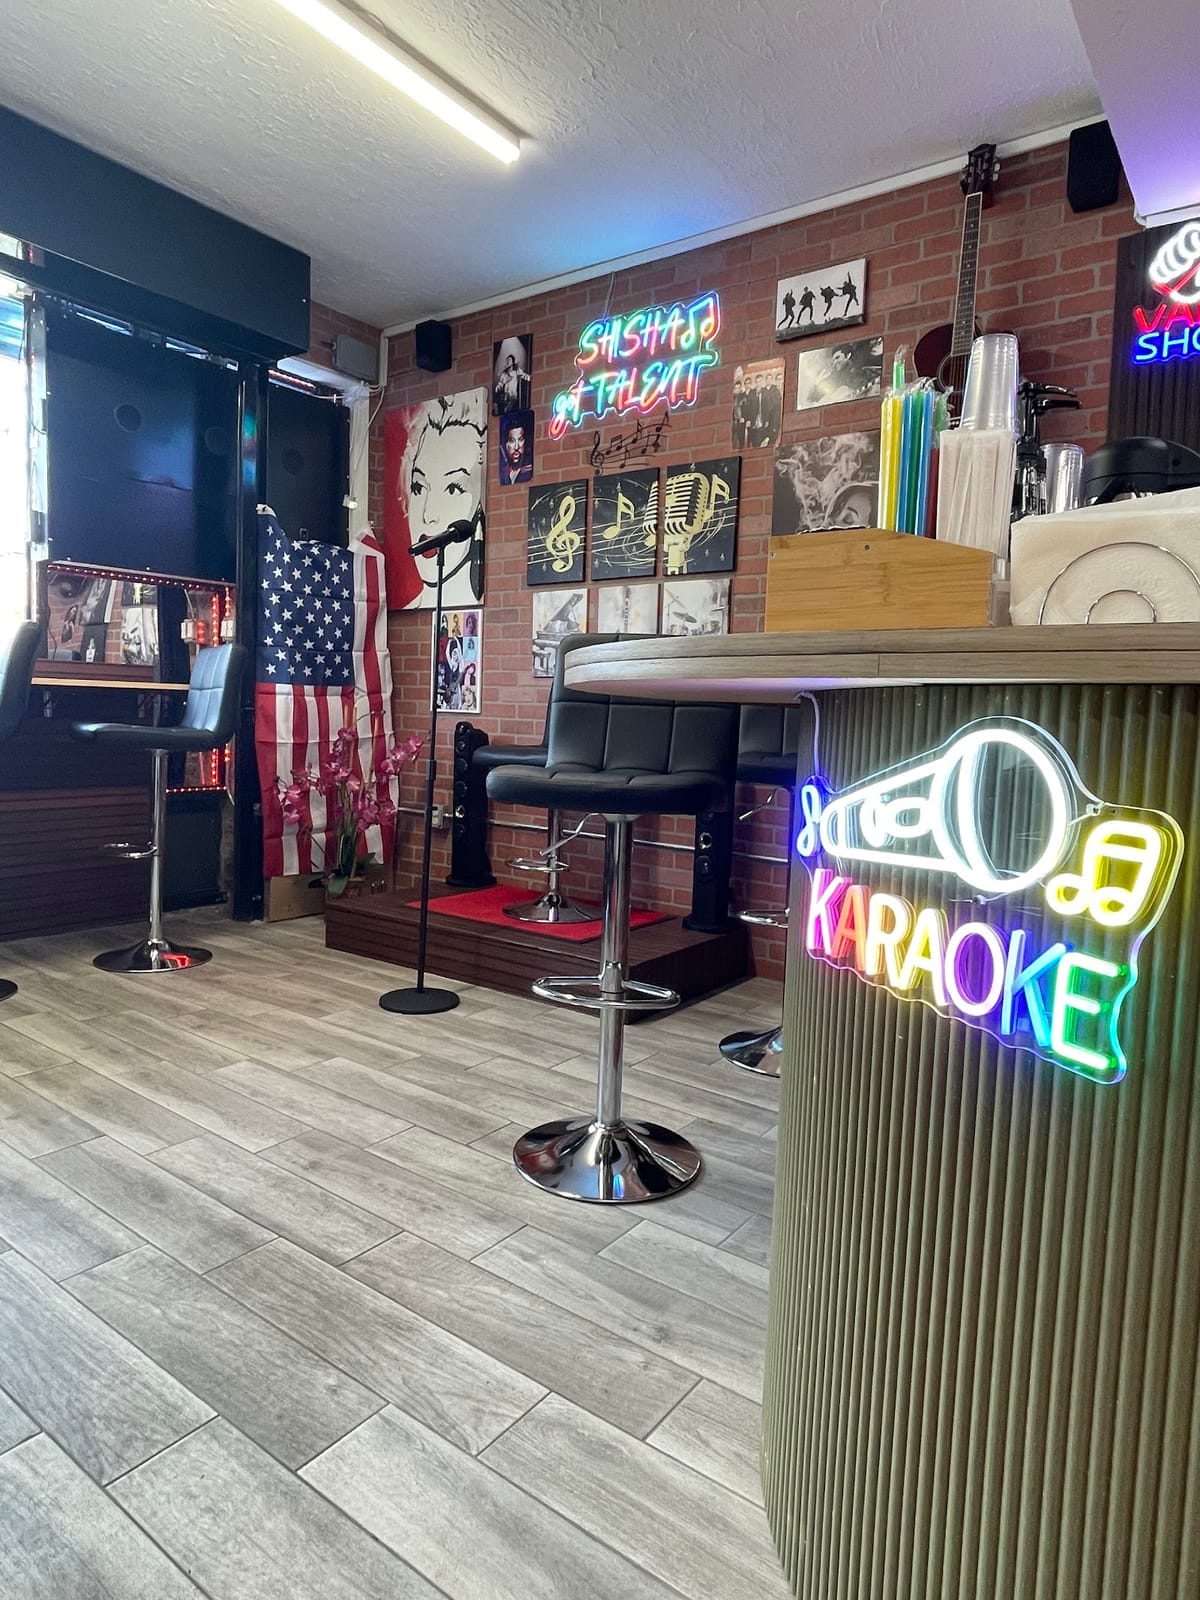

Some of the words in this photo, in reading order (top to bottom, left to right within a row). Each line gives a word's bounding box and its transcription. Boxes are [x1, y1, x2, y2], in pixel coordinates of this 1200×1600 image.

[576, 306, 686, 365] SHISHA
[1134, 302, 1200, 333] VA
[549, 379, 595, 436] got
[589, 353, 713, 414] TALENT
[806, 867, 1129, 1071] KARAOKE
